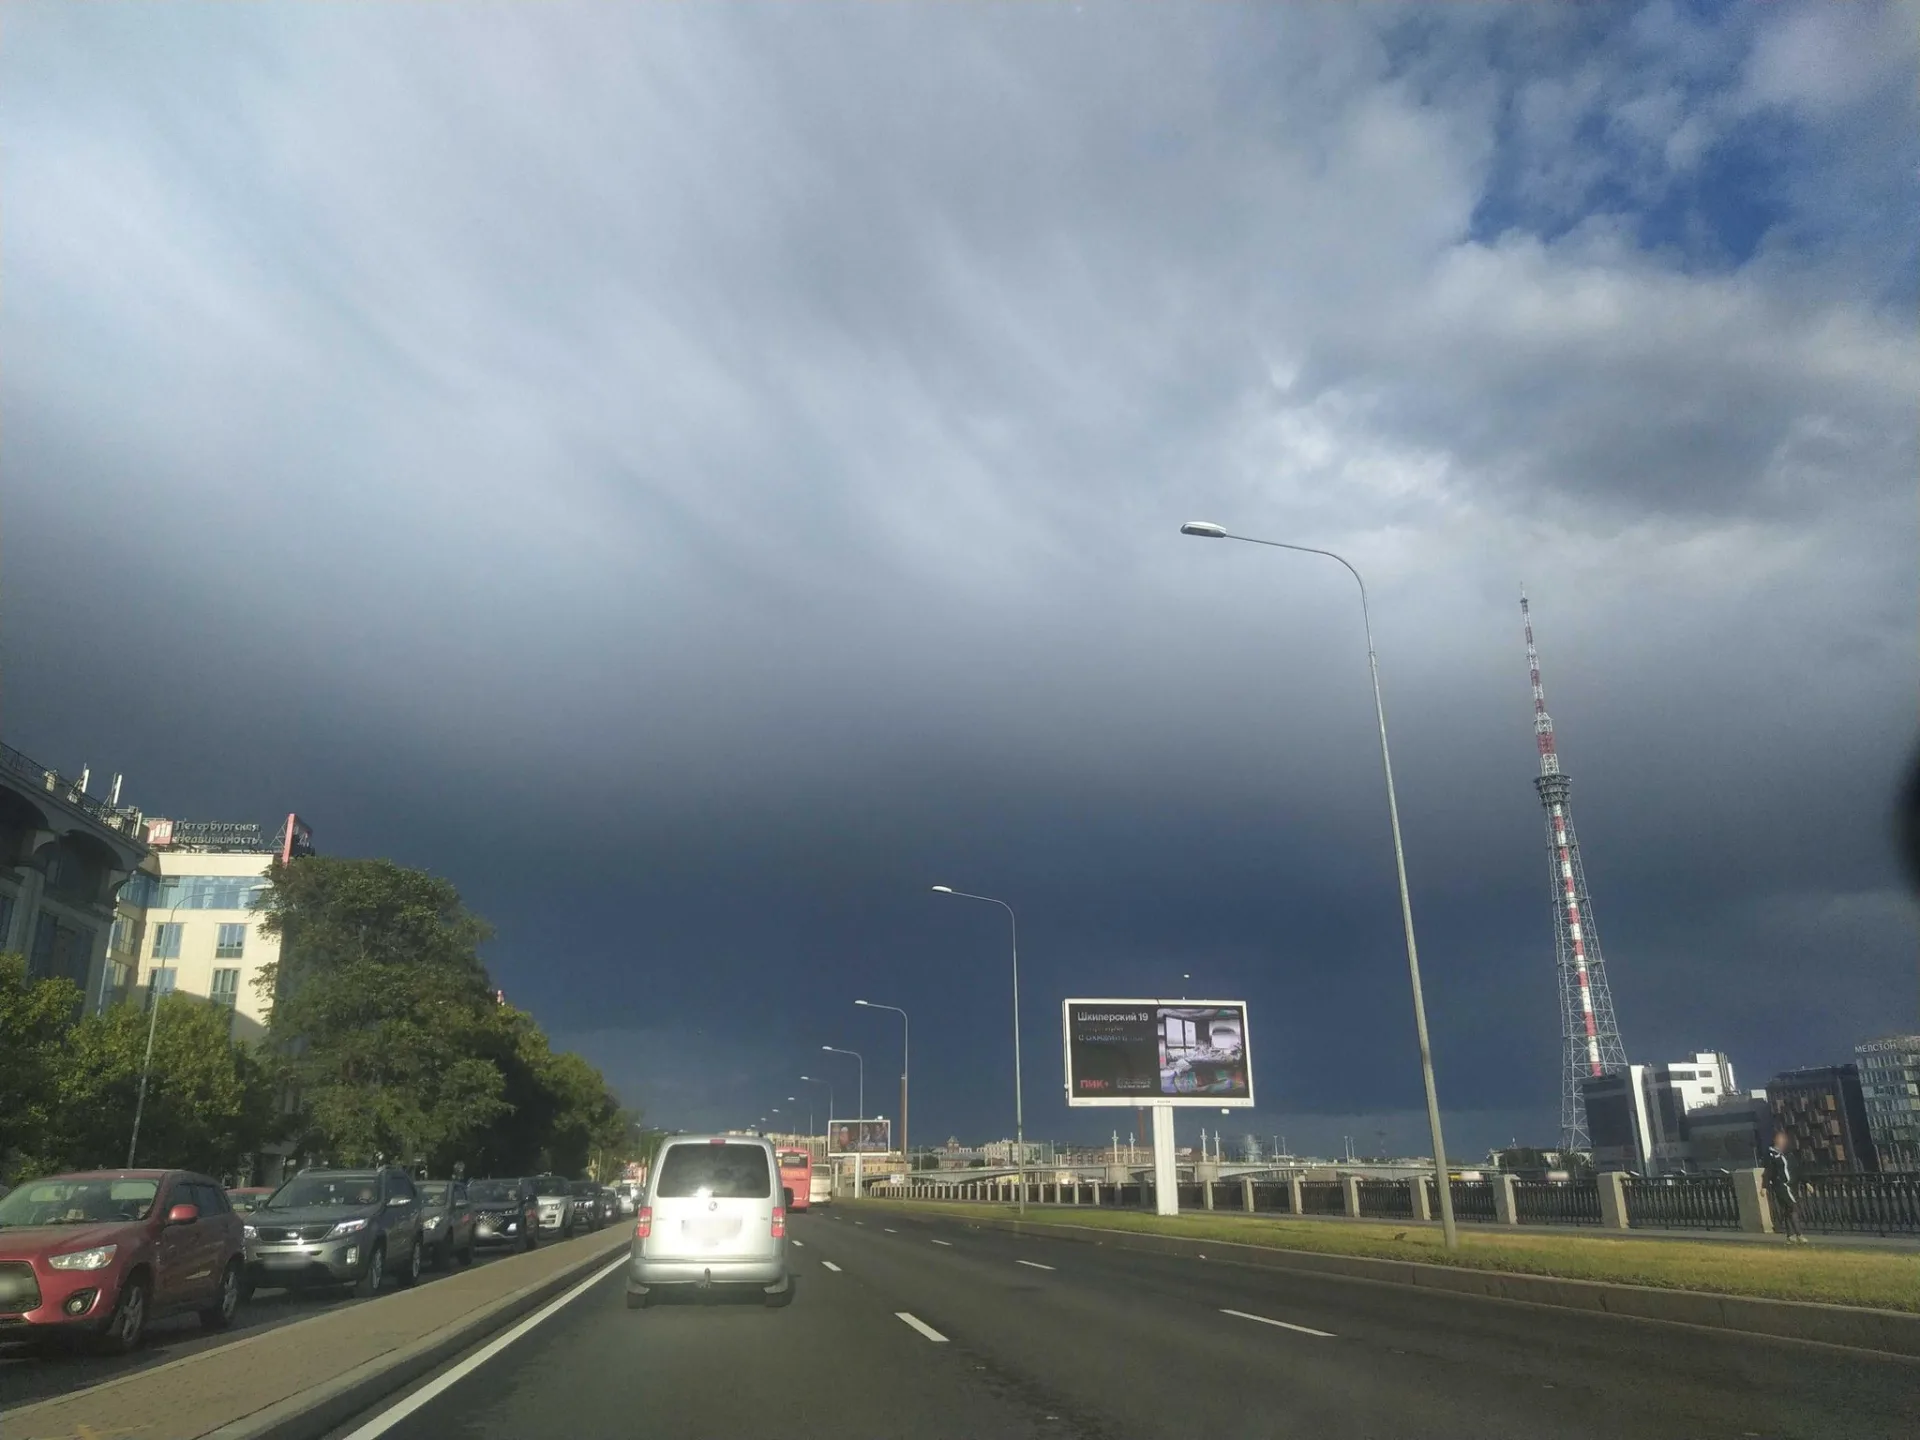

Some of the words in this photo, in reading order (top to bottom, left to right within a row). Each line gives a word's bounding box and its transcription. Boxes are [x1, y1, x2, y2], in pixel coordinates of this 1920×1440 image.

[175, 820, 260, 832] Петербургская
[1077, 1012, 1137, 1022] Шкиперский
[1139, 1012, 1149, 1021] 19
